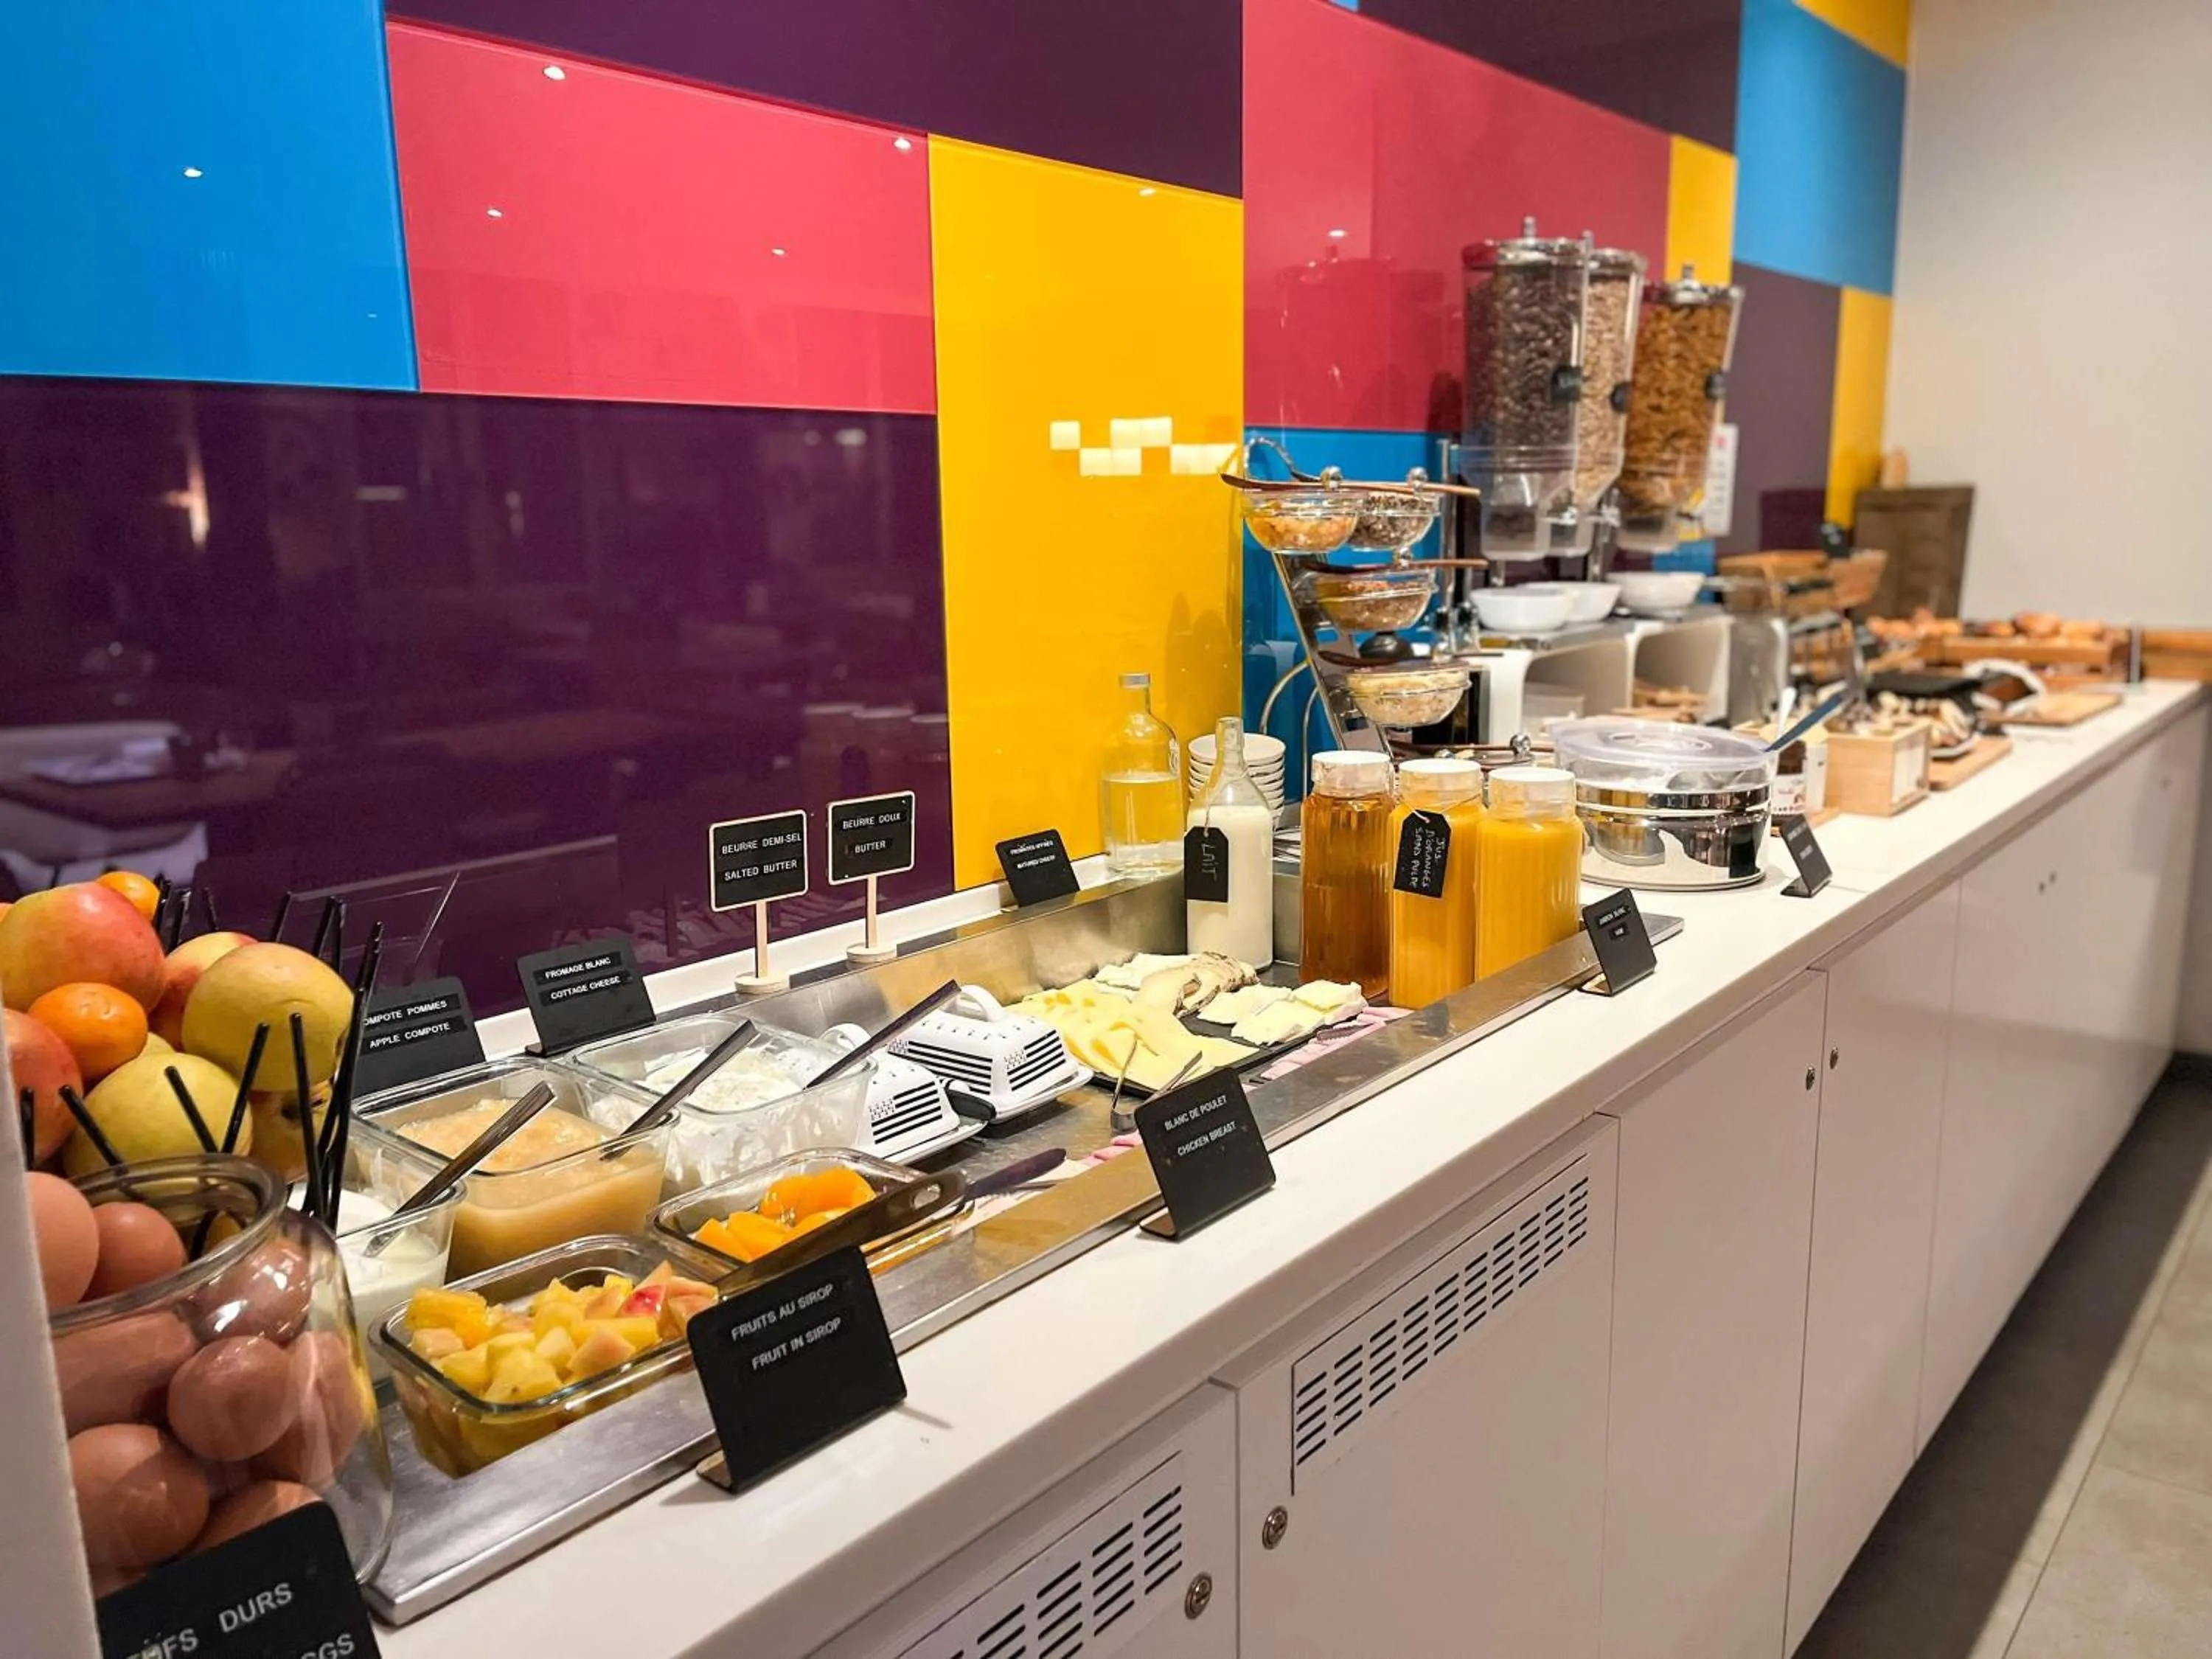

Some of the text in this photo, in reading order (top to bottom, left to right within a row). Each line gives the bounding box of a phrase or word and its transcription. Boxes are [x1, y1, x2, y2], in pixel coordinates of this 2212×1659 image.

[842, 816, 875, 830] BEURRE
[722, 840, 758, 855] BEURRE
[855, 840, 886, 853] BUTTER
[725, 859, 797, 881] SALTED BUTTER
[546, 957, 611, 979] FROMAGE BLANC
[551, 975, 621, 999] COTTAGE CHEESE
[362, 1001, 448, 1026] OMPOTE POMMES
[369, 1022, 451, 1049] APPLE COMPOTE
[1164, 1095, 1228, 1132] BLANC DE POULET
[1178, 1121, 1237, 1156] CHICKEN BREAST
[731, 1284, 834, 1342] FRUITS AU SIROP
[751, 1316, 841, 1371] FRUIT IN SIROP
[218, 1582, 293, 1632] DURS
